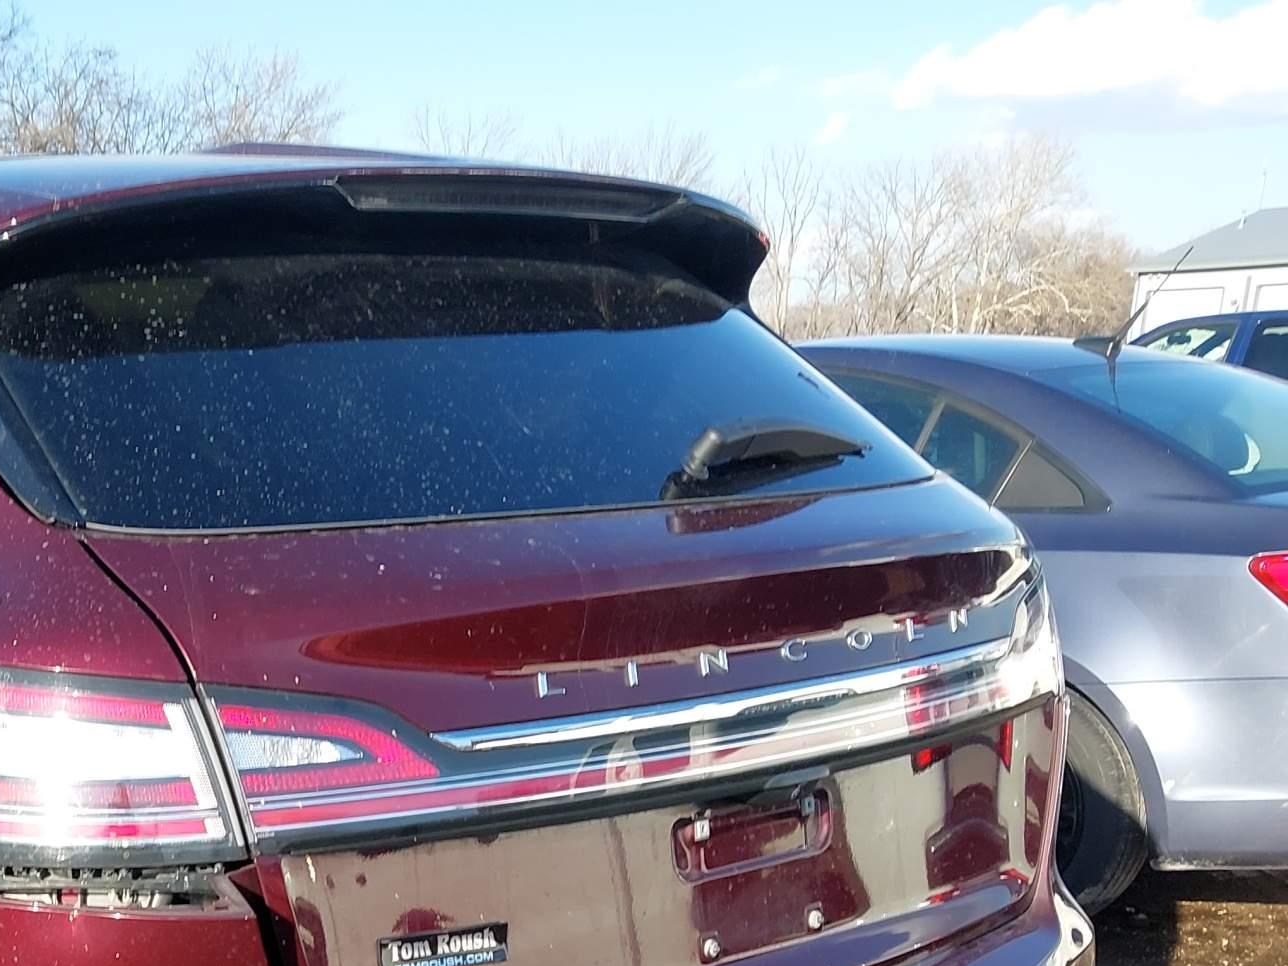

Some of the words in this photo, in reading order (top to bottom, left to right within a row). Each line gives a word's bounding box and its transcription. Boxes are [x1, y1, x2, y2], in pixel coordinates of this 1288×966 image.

[536, 608, 969, 698] LINCOLN
[388, 940, 432, 962] Tom
[436, 928, 497, 954] Roush
